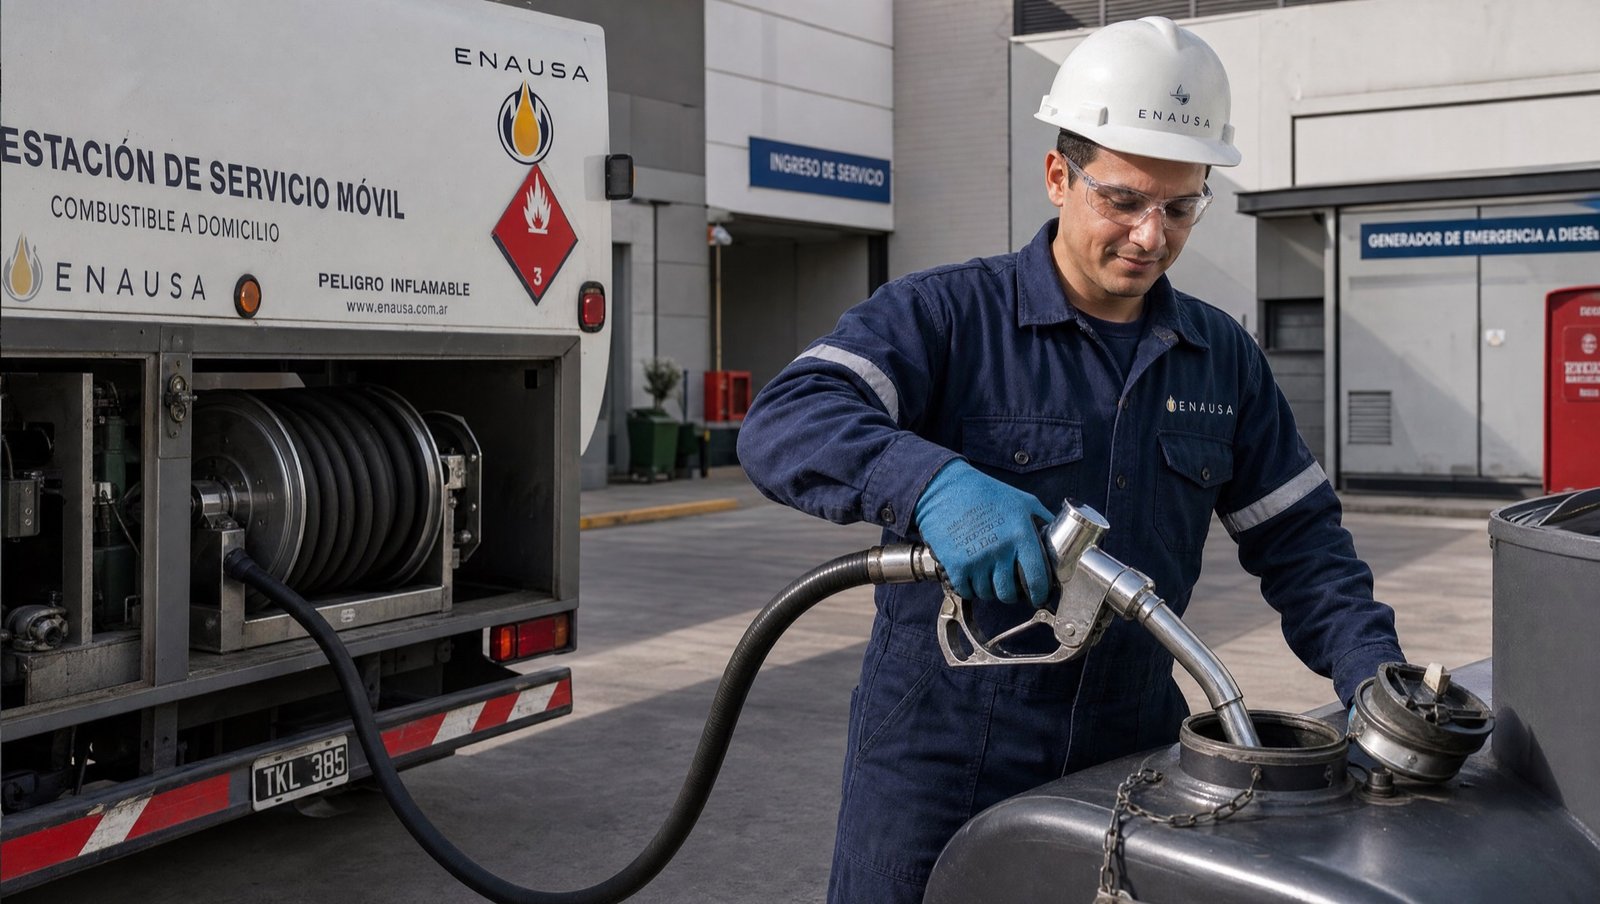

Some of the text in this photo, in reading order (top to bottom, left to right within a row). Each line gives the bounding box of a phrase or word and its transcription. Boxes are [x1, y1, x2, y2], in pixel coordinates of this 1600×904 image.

[455, 47, 590, 82] ENAUSA
[1138, 109, 1211, 129] ENAUSA
[1, 126, 405, 220] ESTACIÓN DE SERVICIO MÓVIL
[770, 152, 884, 187] INGRESO DE SERVICIO
[51, 195, 280, 243] COMBUSTIBLE A DOMICILIO
[1368, 232, 1442, 248] GENERADOR
[1444, 230, 1461, 246] DE
[1463, 228, 1544, 245] EMERGENCIA
[1546, 228, 1556, 242] A
[56, 262, 206, 300] ENAUSA
[318, 272, 471, 297] PELIGRO INFLAMABLE
[533, 266, 542, 286] 3
[346, 299, 448, 316] www.enausa.com.ar
[1179, 400, 1234, 416] ENAUSA
[263, 747, 345, 797] TKL 385
